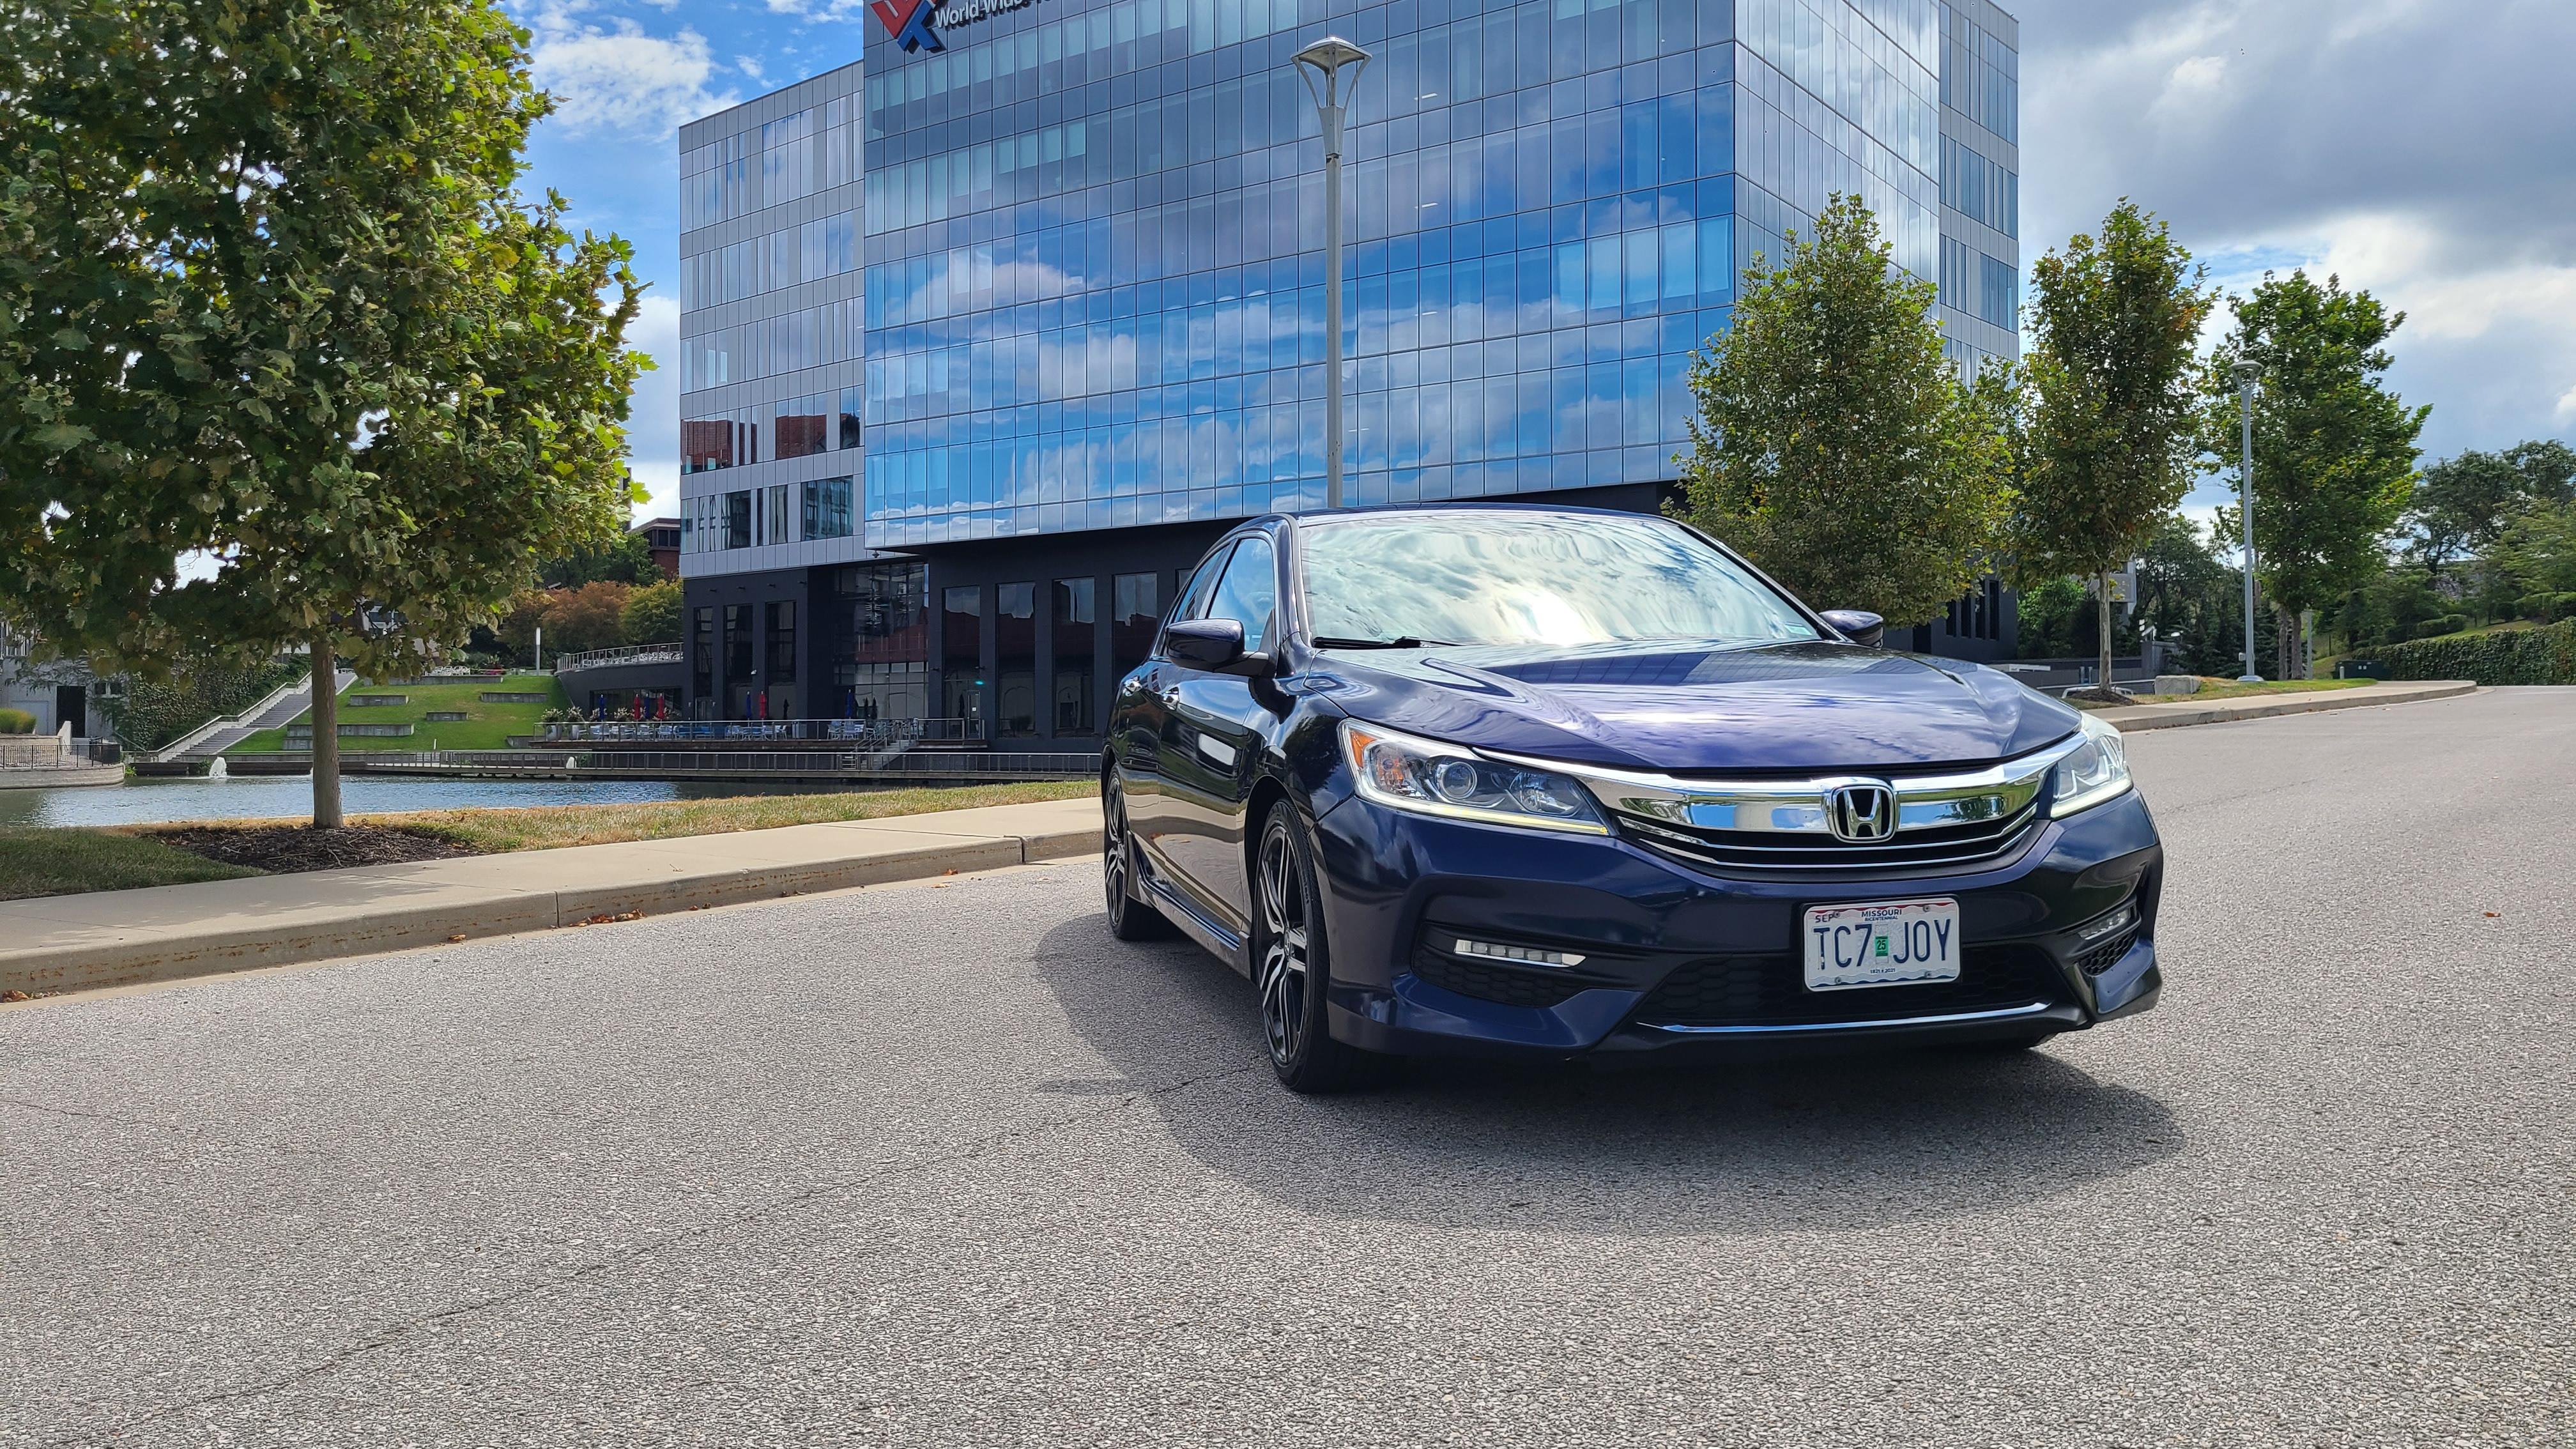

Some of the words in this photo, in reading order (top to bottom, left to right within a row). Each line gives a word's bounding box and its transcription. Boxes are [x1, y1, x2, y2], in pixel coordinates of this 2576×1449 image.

[935, 0, 979, 27] World
[1861, 908, 1902, 917] MISSOURI
[1815, 914, 1834, 923] SEP
[1813, 924, 1872, 970] TC7
[1893, 919, 1951, 963] JOY
[1876, 940, 1887, 950] 25
